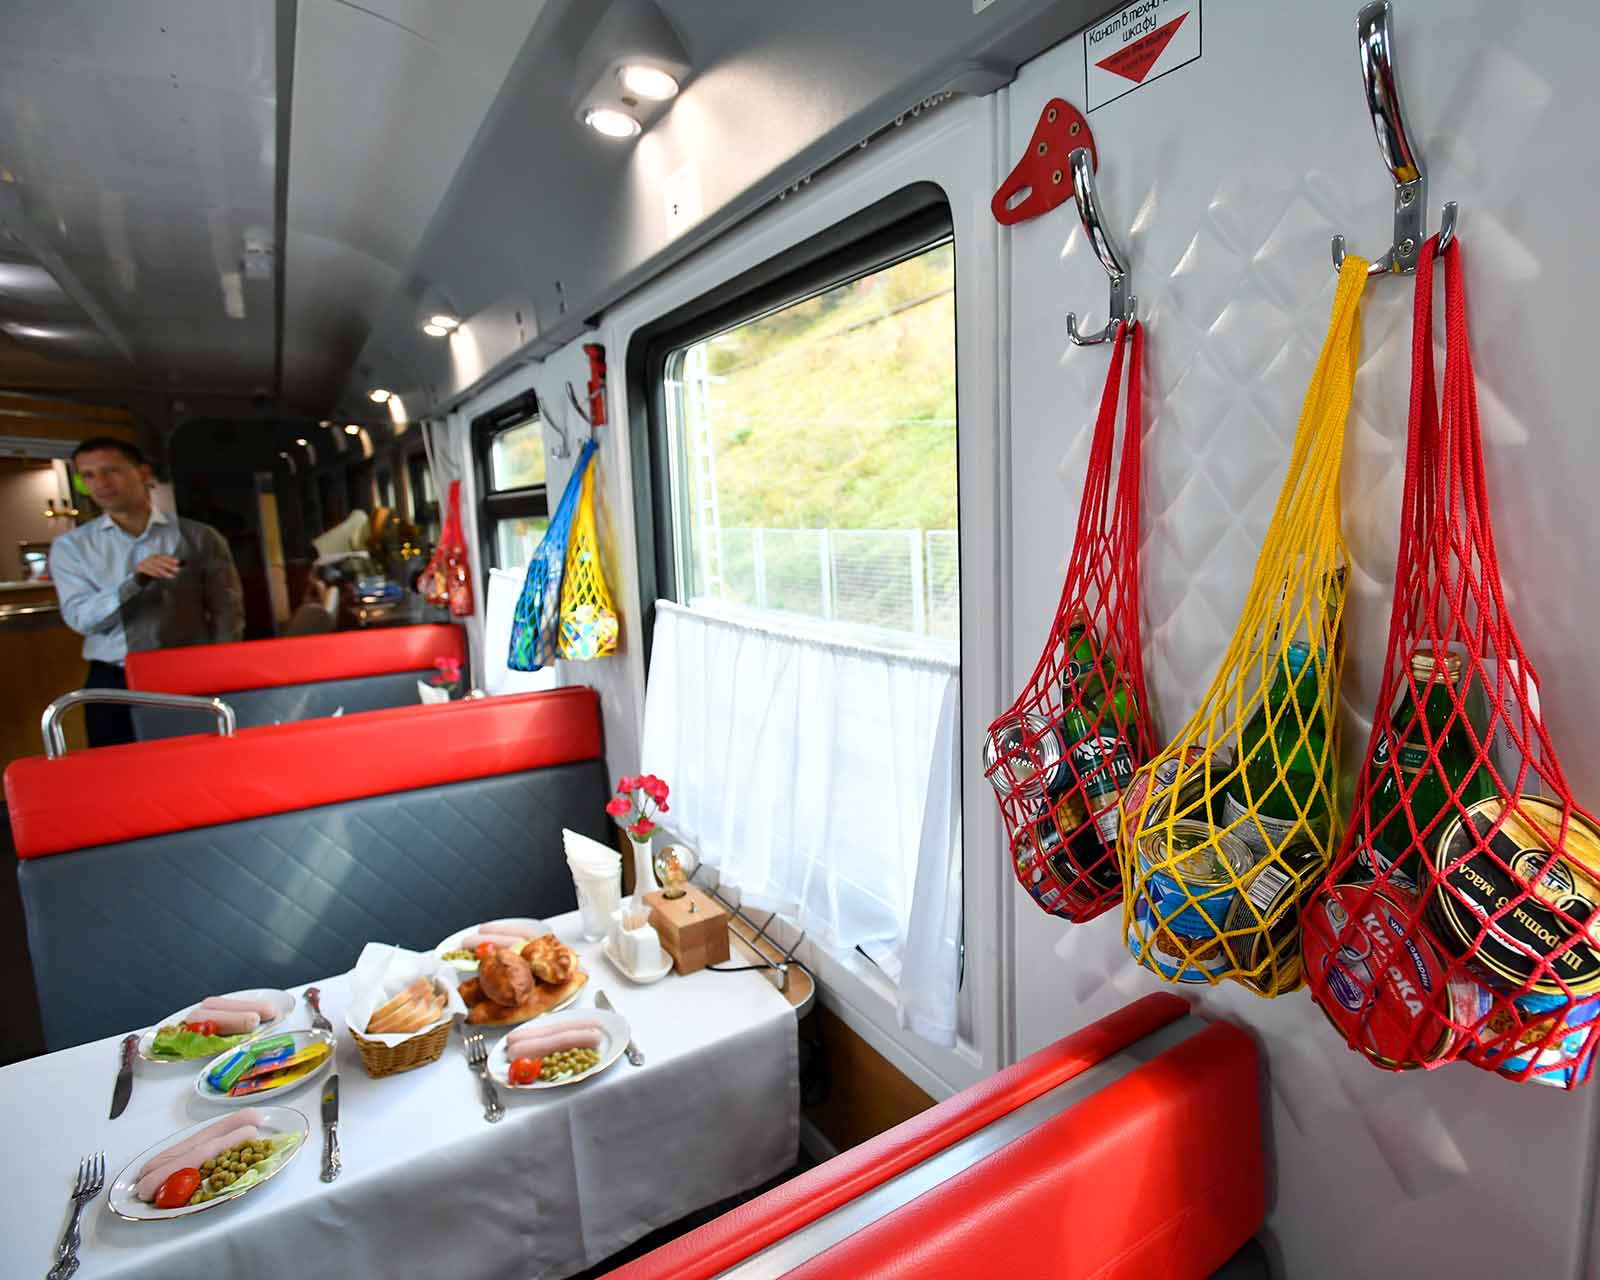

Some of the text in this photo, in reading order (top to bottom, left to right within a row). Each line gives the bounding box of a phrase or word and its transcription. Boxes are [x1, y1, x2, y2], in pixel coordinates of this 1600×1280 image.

[1089, 19, 1121, 46] Канат
[1121, 10, 1128, 26] в
[1122, 14, 1157, 42] шкафу
[1512, 907, 1584, 971] Шроты
